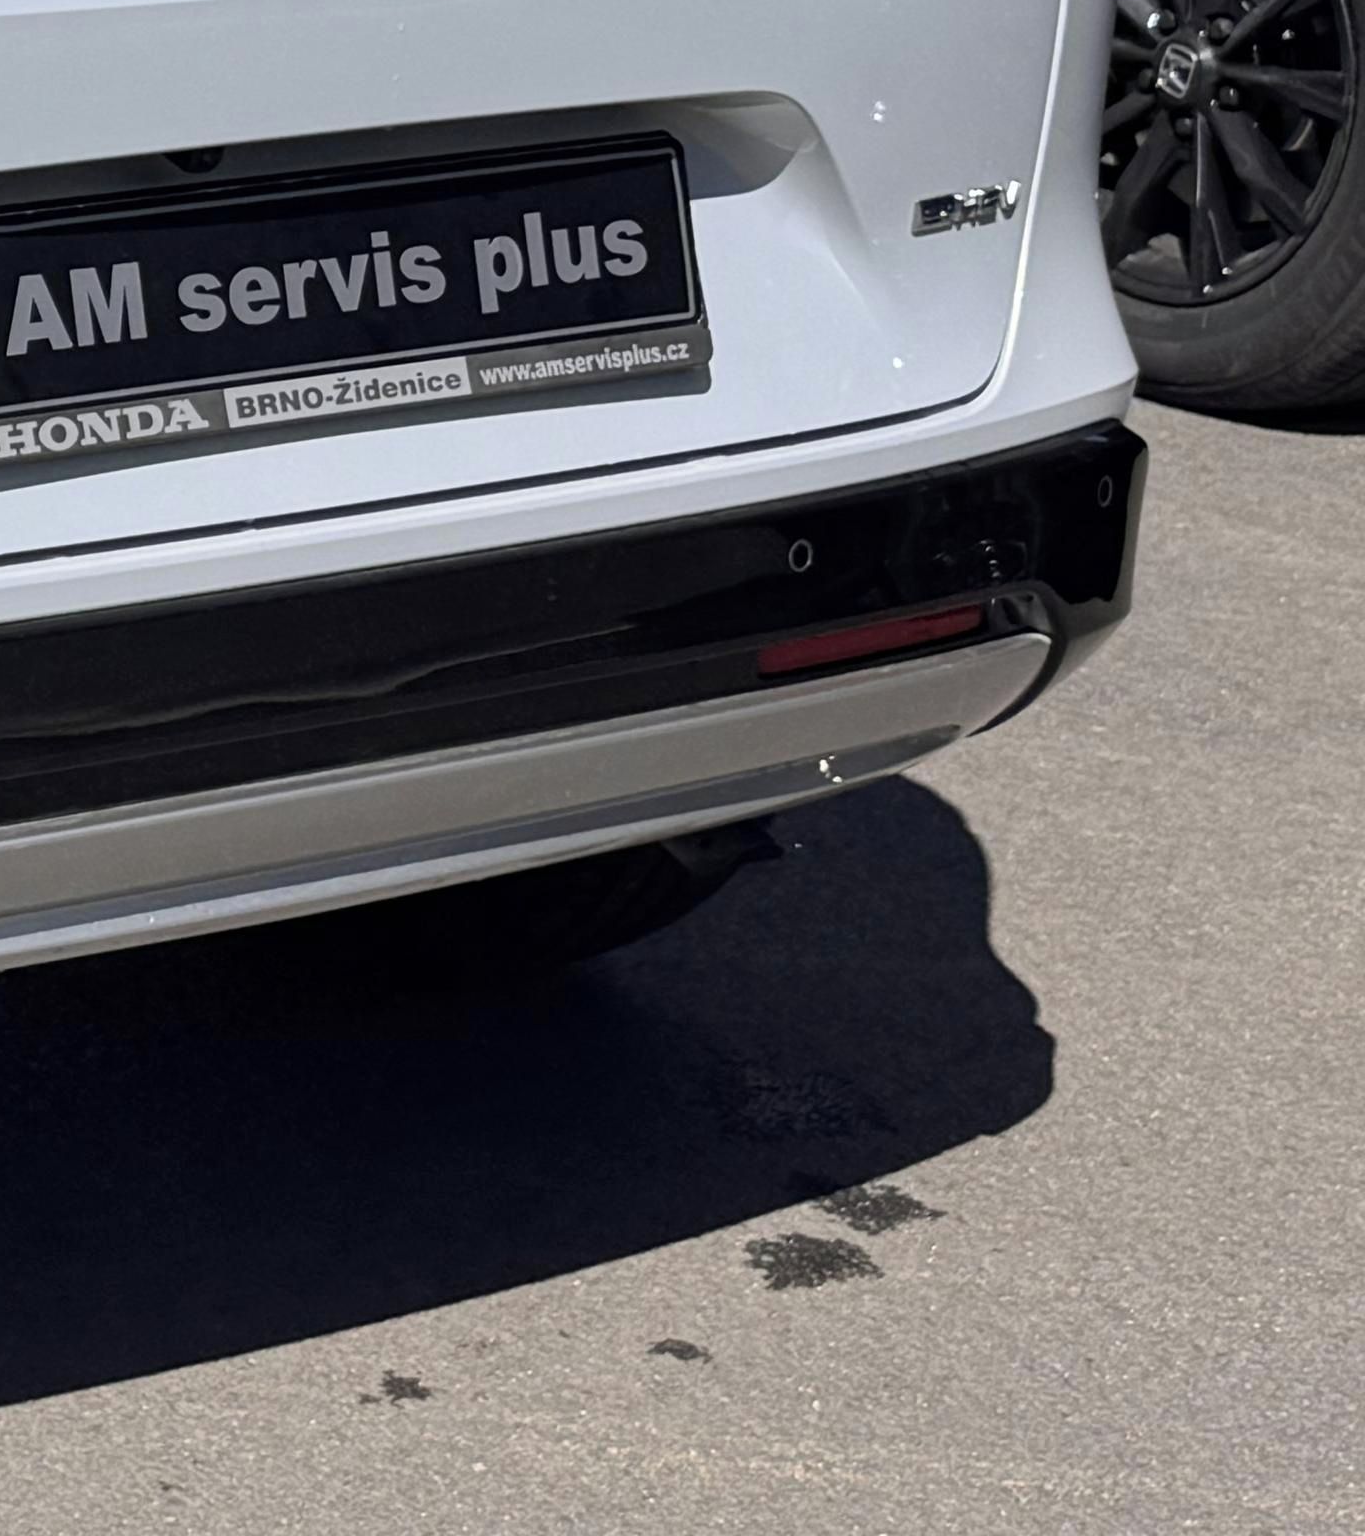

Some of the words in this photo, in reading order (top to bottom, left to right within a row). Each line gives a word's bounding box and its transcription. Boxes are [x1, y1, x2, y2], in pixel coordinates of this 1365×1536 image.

[6, 261, 148, 357] AM
[177, 230, 447, 332] servis
[473, 211, 648, 314] plus
[235, 371, 462, 419] BRNO-Židenice
[479, 342, 690, 386] www.amservisplus.cz
